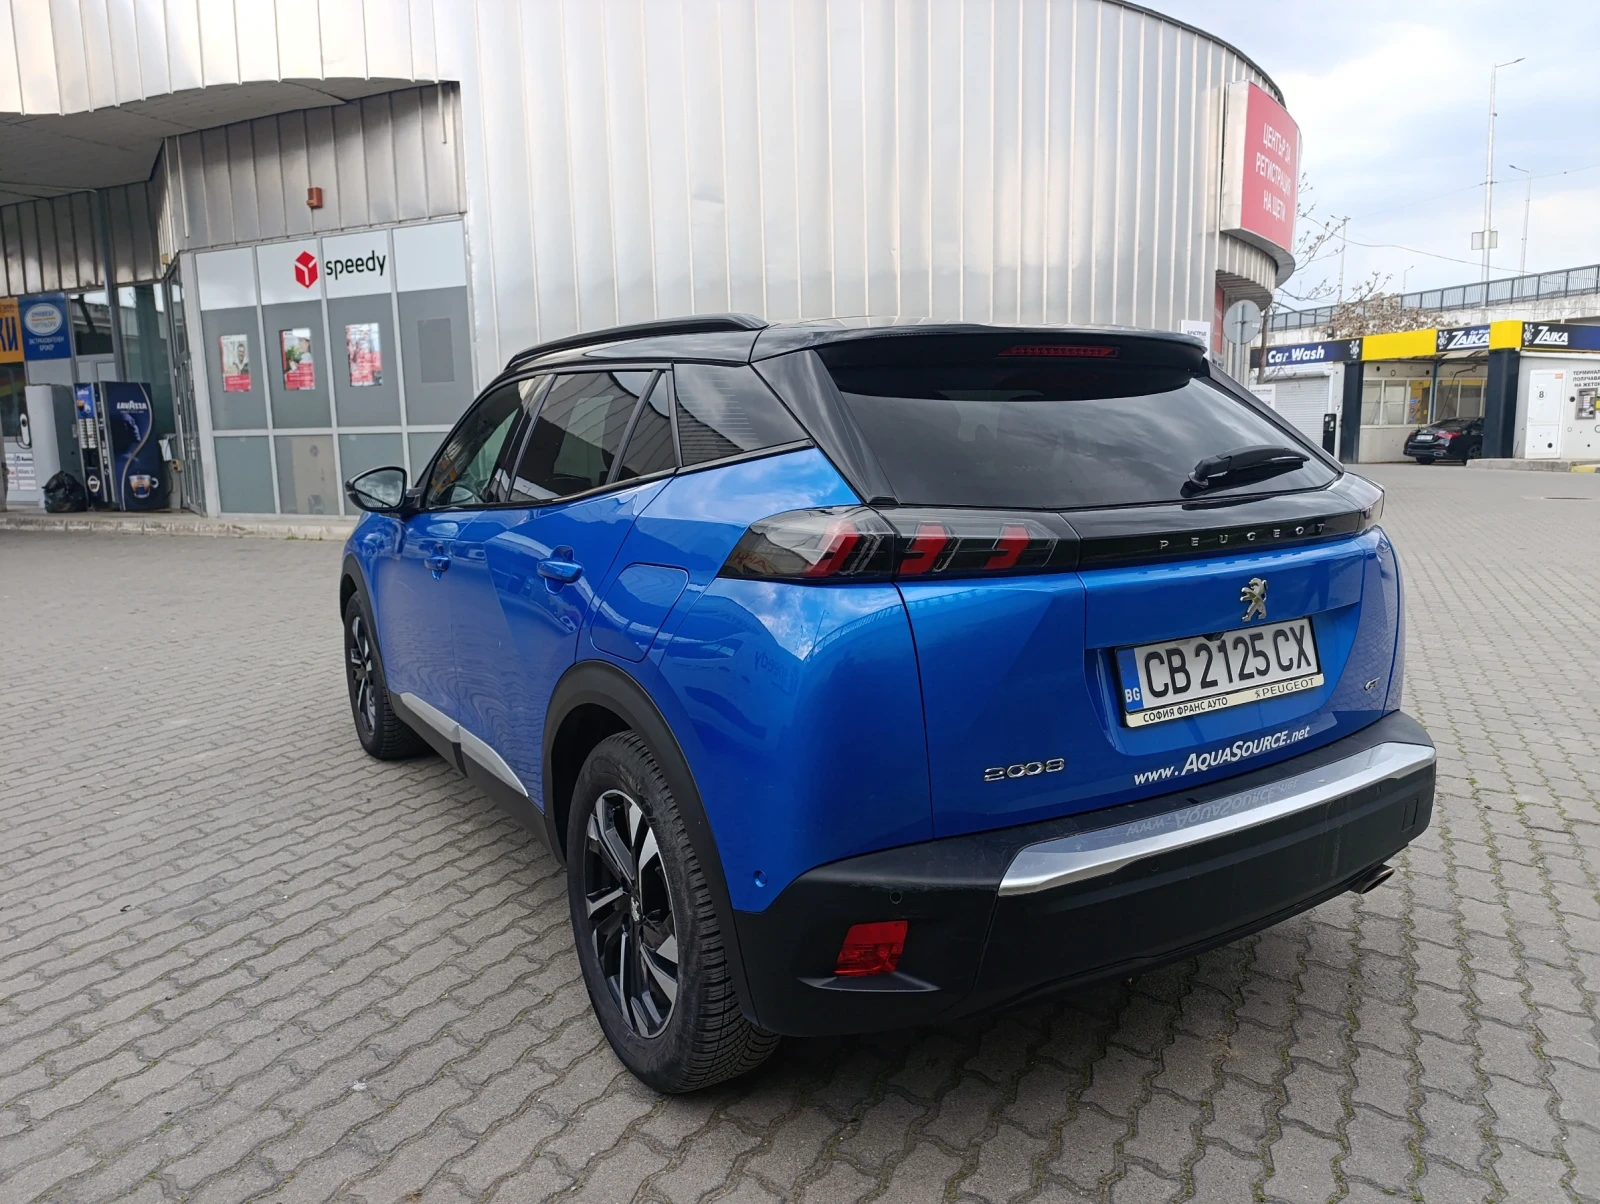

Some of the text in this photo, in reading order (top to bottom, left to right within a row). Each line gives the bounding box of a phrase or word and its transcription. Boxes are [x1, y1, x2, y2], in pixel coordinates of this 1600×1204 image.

[1263, 122, 1291, 165] ЦЕНТЪР ЗА
[1255, 151, 1291, 197] РЕГИСТРАЦИЯ
[1263, 189, 1286, 222] НА ЩЕТИ
[325, 249, 386, 280] speedy
[1268, 345, 1325, 363] Car Wash
[116, 400, 148, 409] LAVAZZA
[1159, 523, 1325, 550] PEUGEOT
[1195, 632, 1271, 690] 2125
[1125, 688, 1141, 703] BG
[1262, 677, 1315, 697] PEUGEOT
[1143, 696, 1228, 723] СОФИЯ ФРАНС АУТО
[984, 758, 1065, 782] 2008
